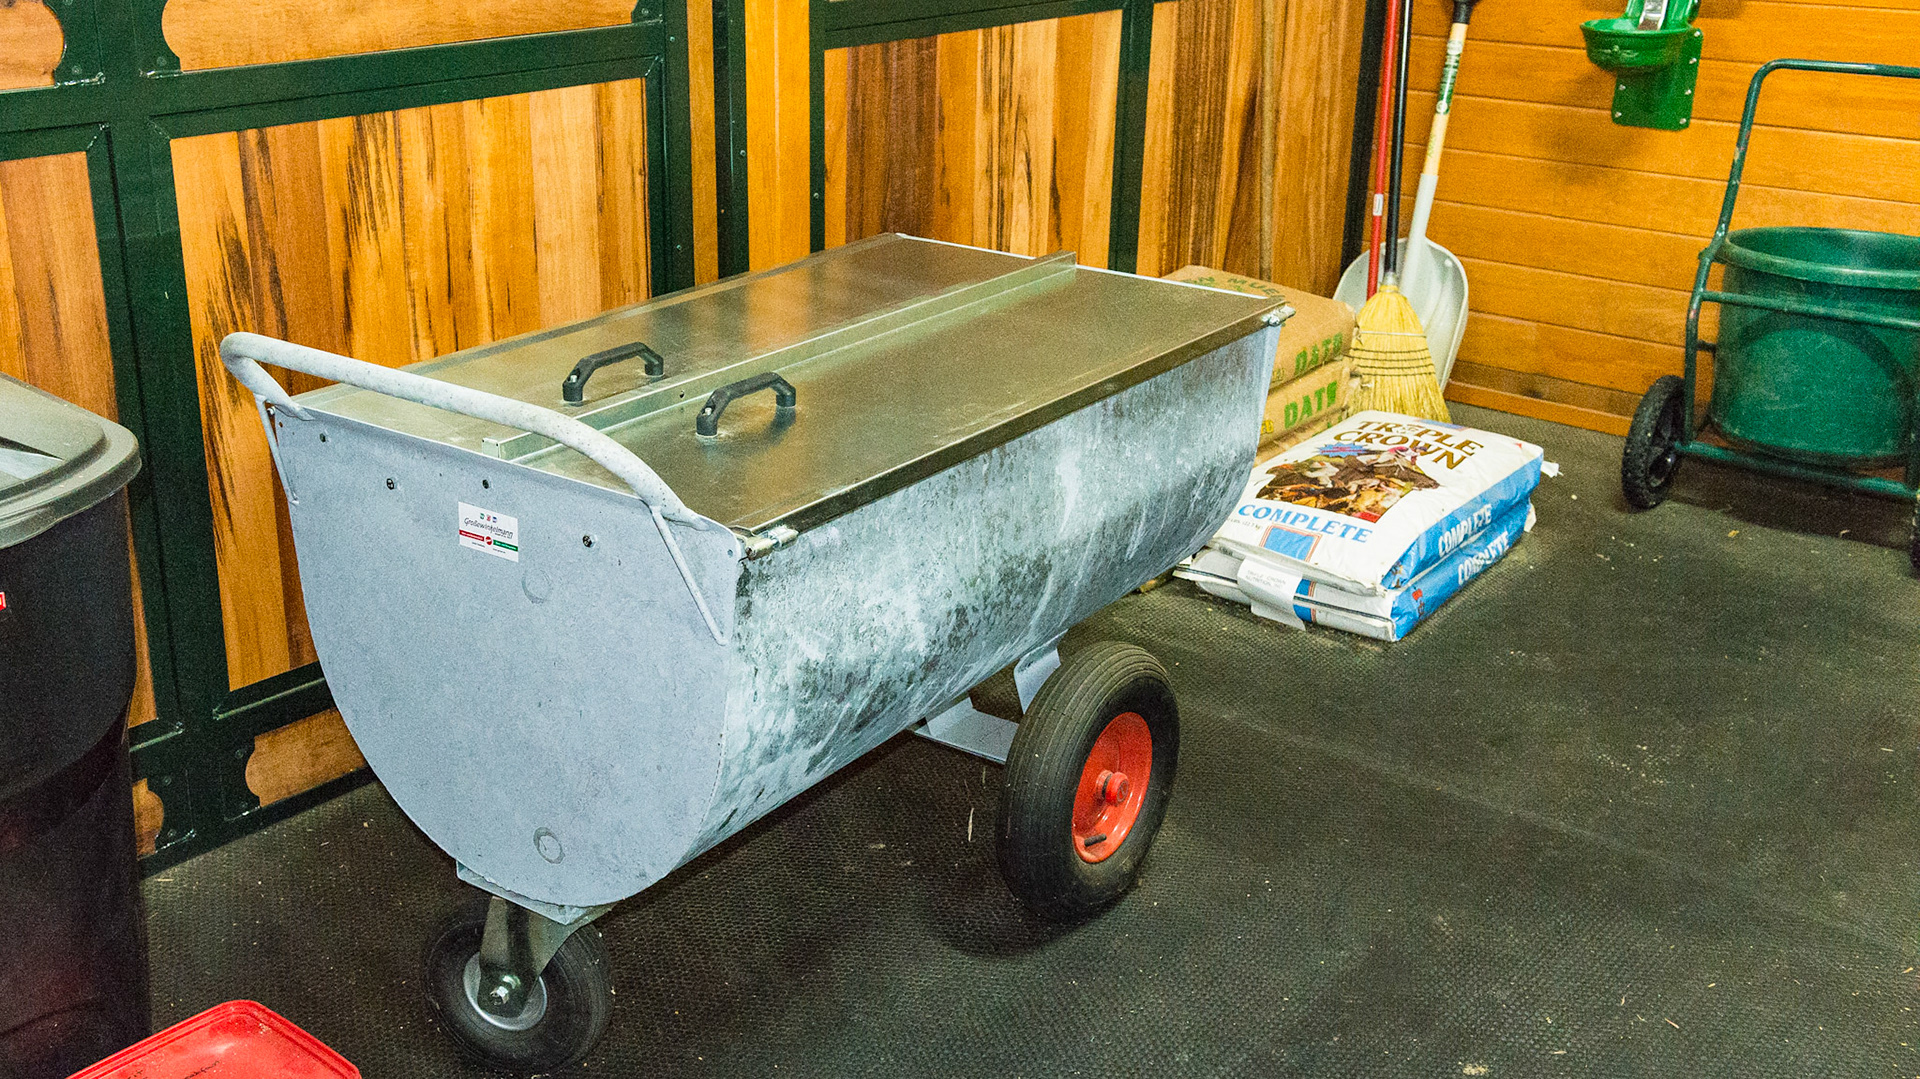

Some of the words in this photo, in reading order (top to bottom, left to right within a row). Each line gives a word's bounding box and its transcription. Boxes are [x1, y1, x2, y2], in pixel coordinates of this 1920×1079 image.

[1333, 430, 1467, 470] CROWN
[1238, 504, 1373, 543] COMPLETE
[1438, 504, 1492, 558] COMPLETE
[1458, 531, 1510, 585] COMPLETE
